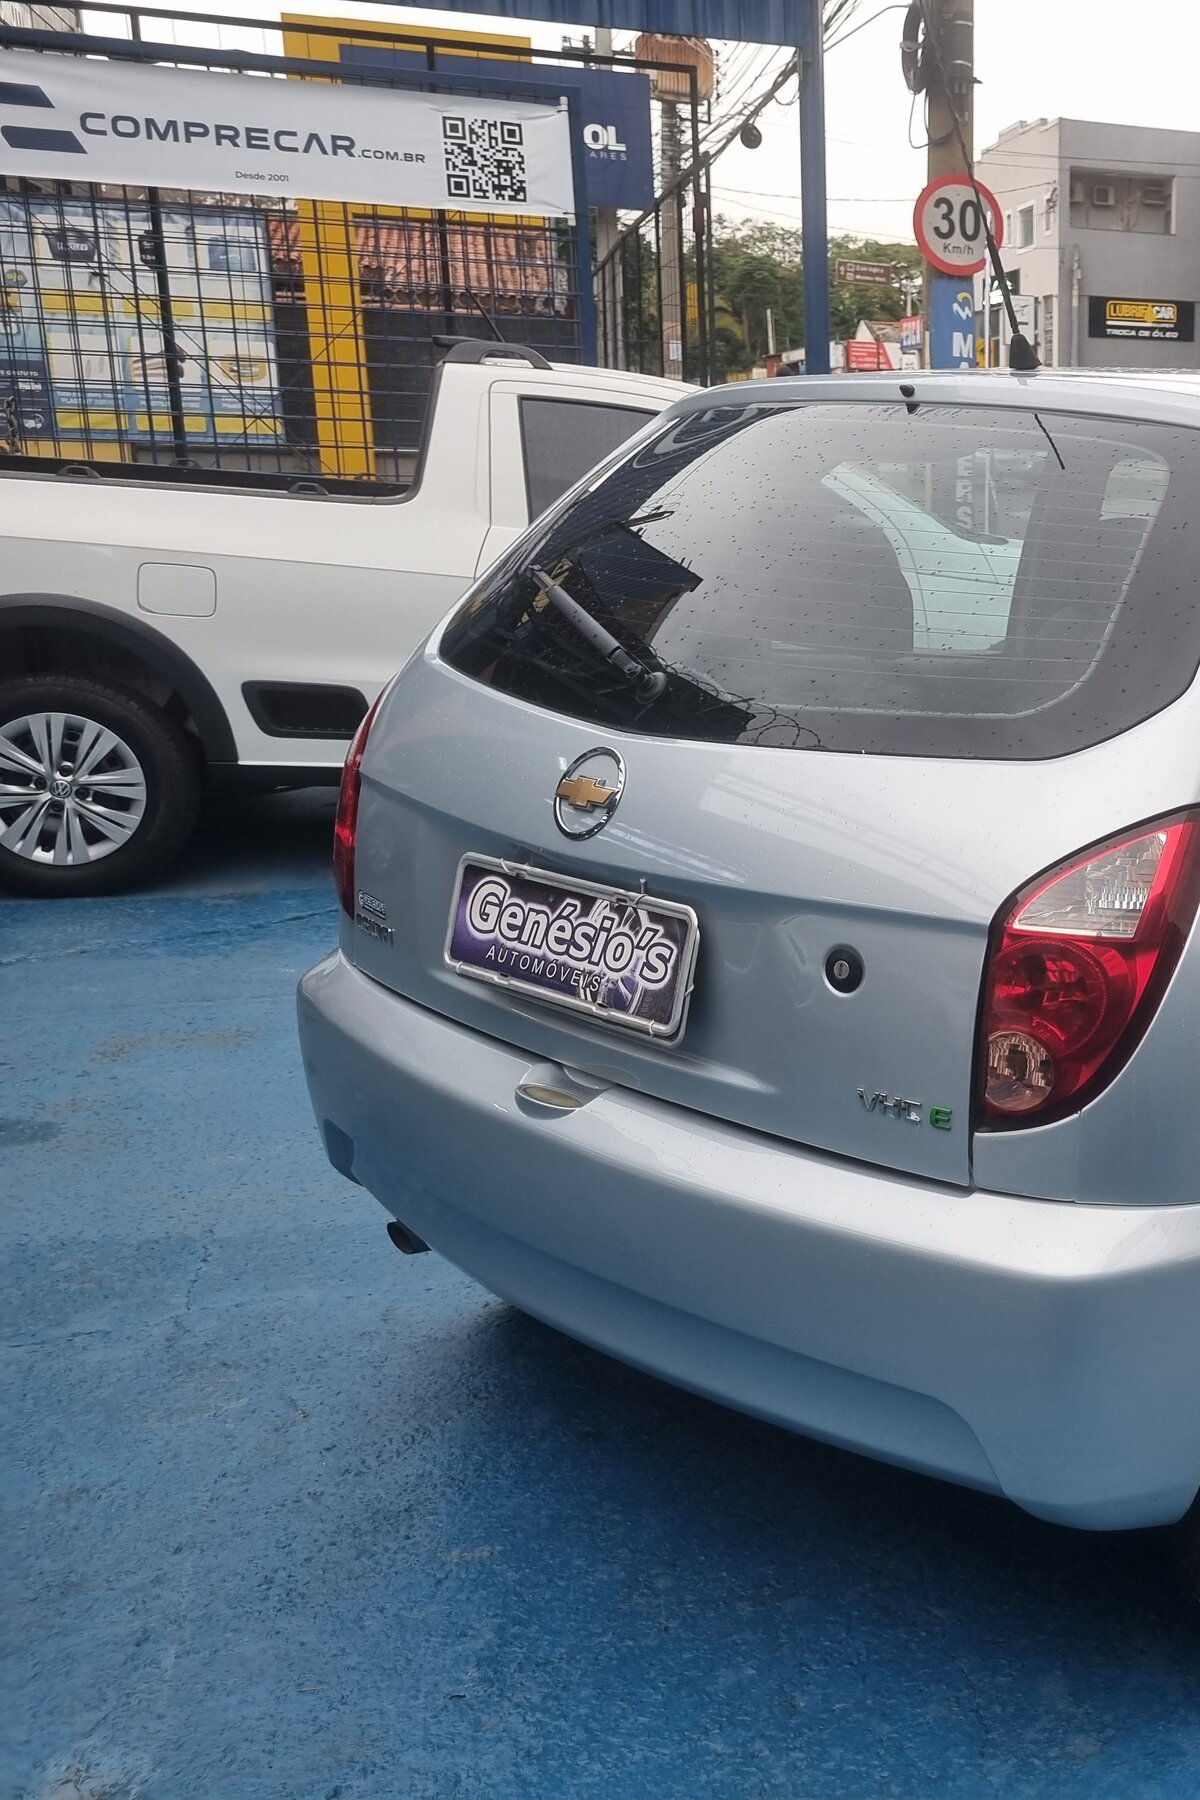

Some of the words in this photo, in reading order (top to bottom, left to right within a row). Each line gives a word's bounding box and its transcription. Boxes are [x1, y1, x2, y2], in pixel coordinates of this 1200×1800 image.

[235, 171, 266, 181] Desde
[267, 173, 290, 182] 2001
[933, 197, 980, 242] 30
[943, 242, 975, 256] Km/h
[469, 879, 674, 984] Genésio's
[485, 945, 601, 992] AUTOMÓVEIS
